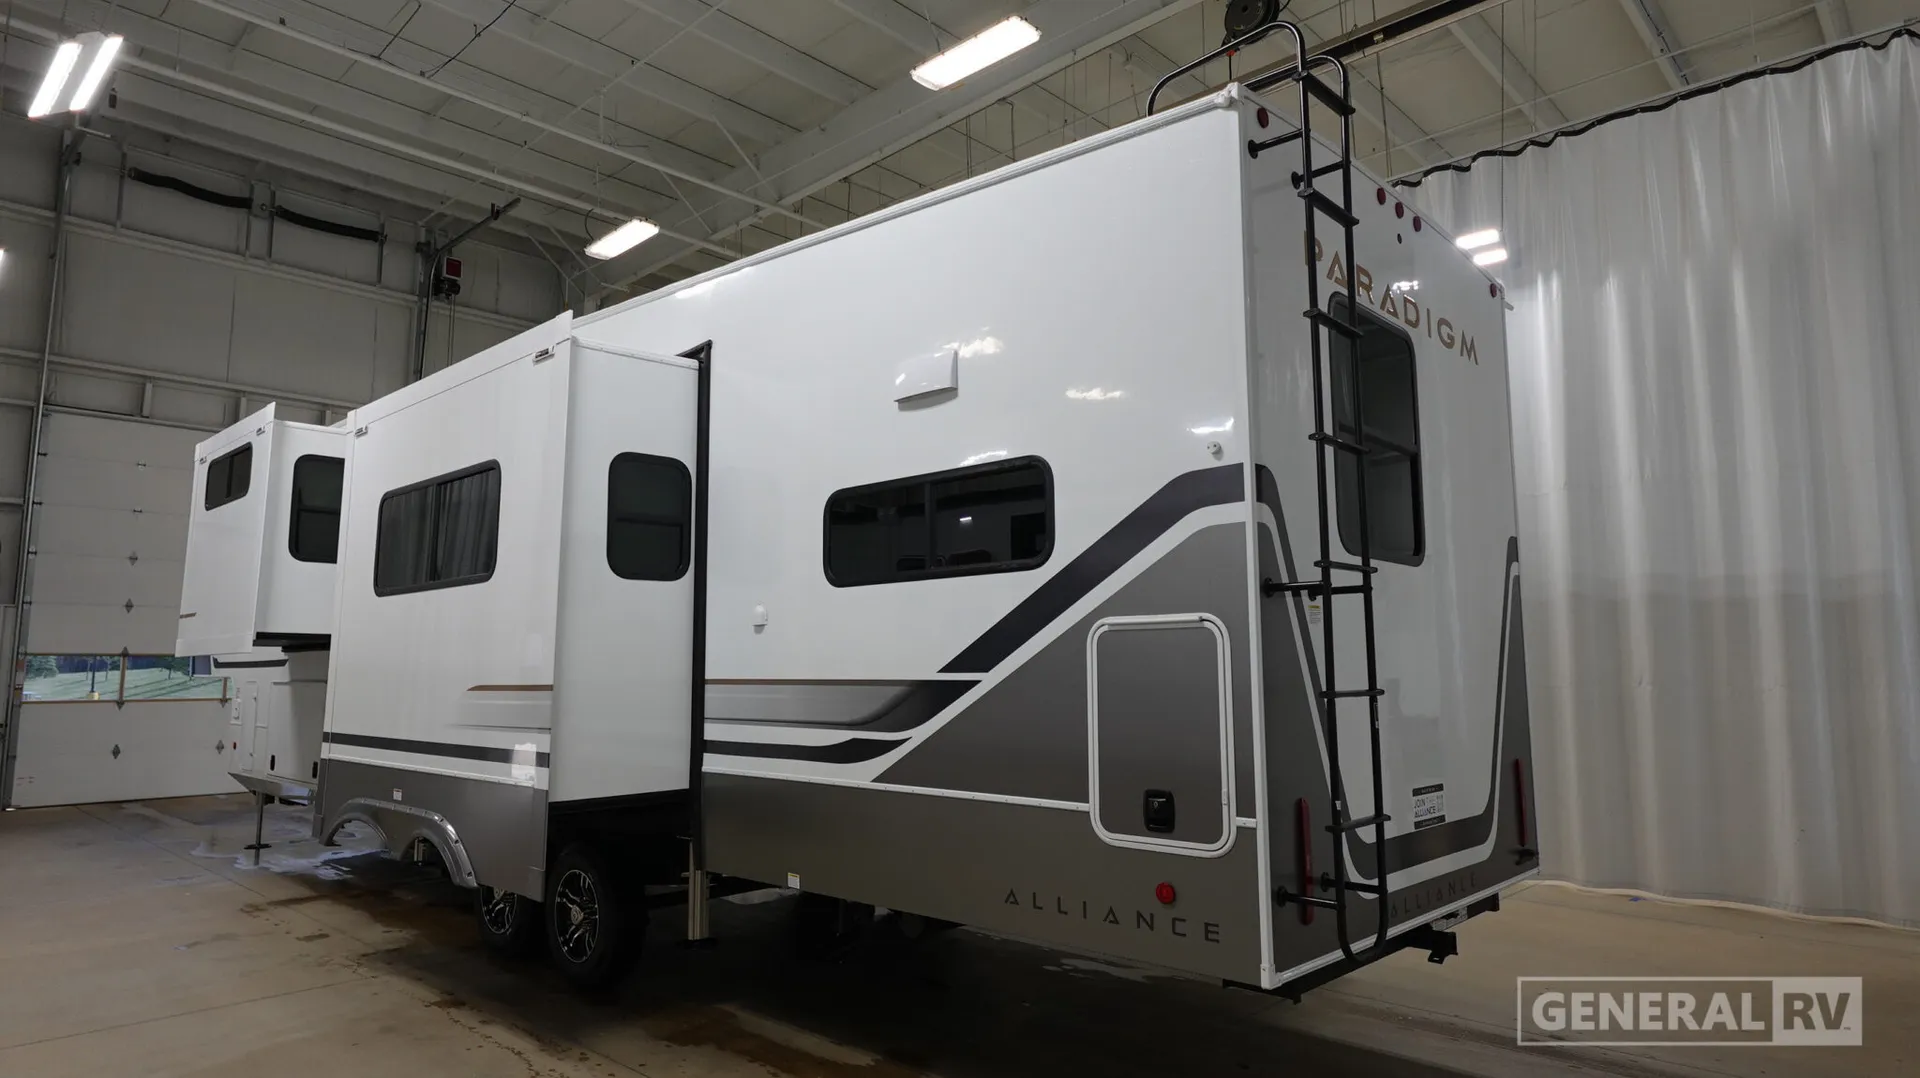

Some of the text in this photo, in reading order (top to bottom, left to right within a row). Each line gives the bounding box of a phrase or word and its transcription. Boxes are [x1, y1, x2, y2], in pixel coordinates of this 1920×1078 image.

[1304, 230, 1479, 366] PARADIGM
[1414, 805, 1436, 818] ALLIANCE
[1004, 888, 1220, 944] ALLIANCE
[1390, 871, 1477, 918] ALLIANCE
